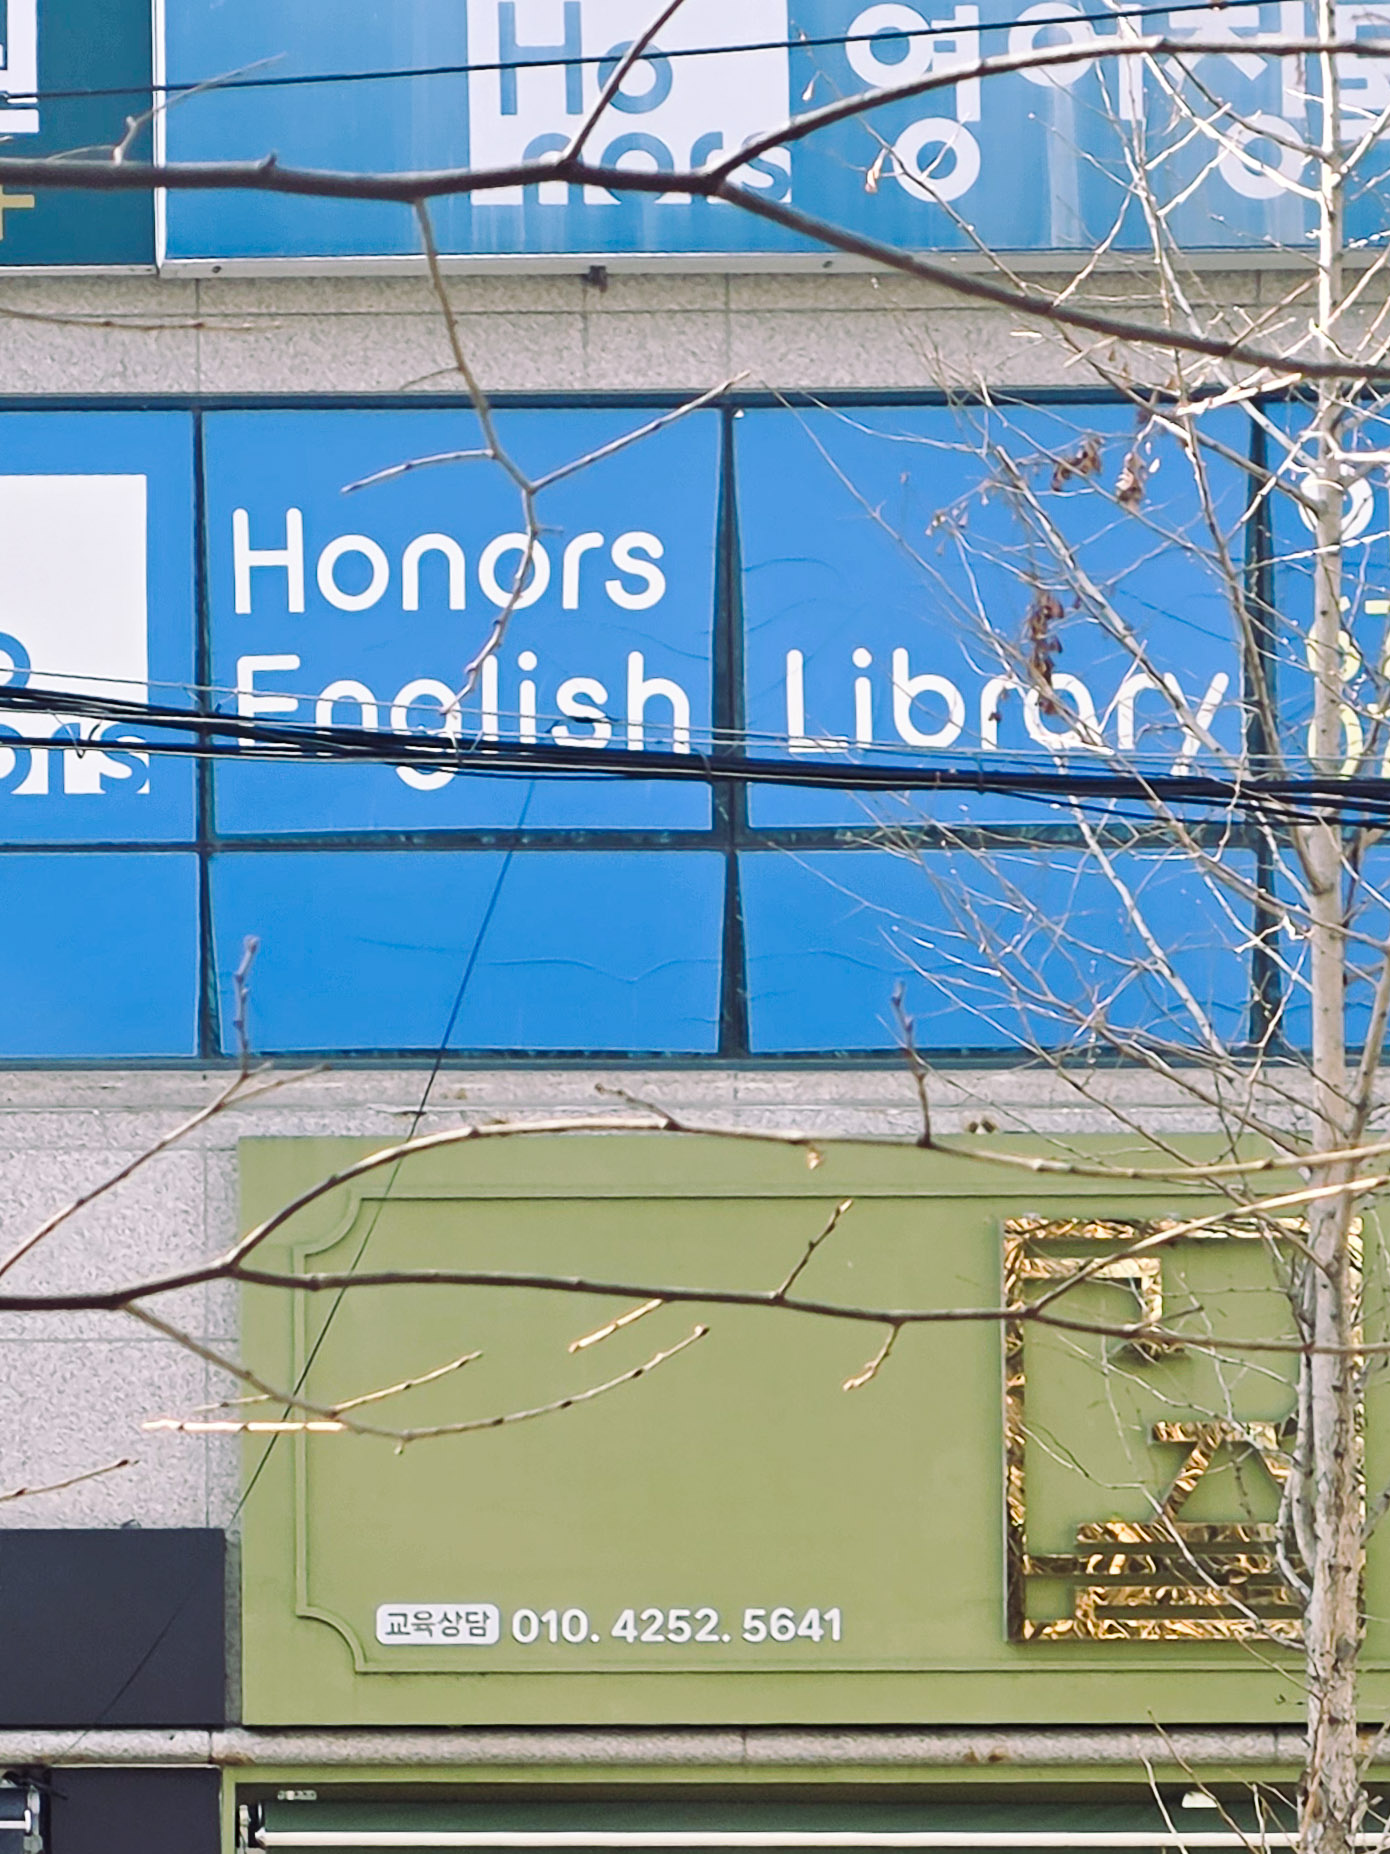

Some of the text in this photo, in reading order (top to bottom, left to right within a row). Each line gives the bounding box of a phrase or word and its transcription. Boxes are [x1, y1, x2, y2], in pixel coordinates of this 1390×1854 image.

[233, 507, 667, 614] Honors
[236, 651, 691, 790] English
[384, 1607, 842, 1644] 교육상담 010. 4252. 5641
